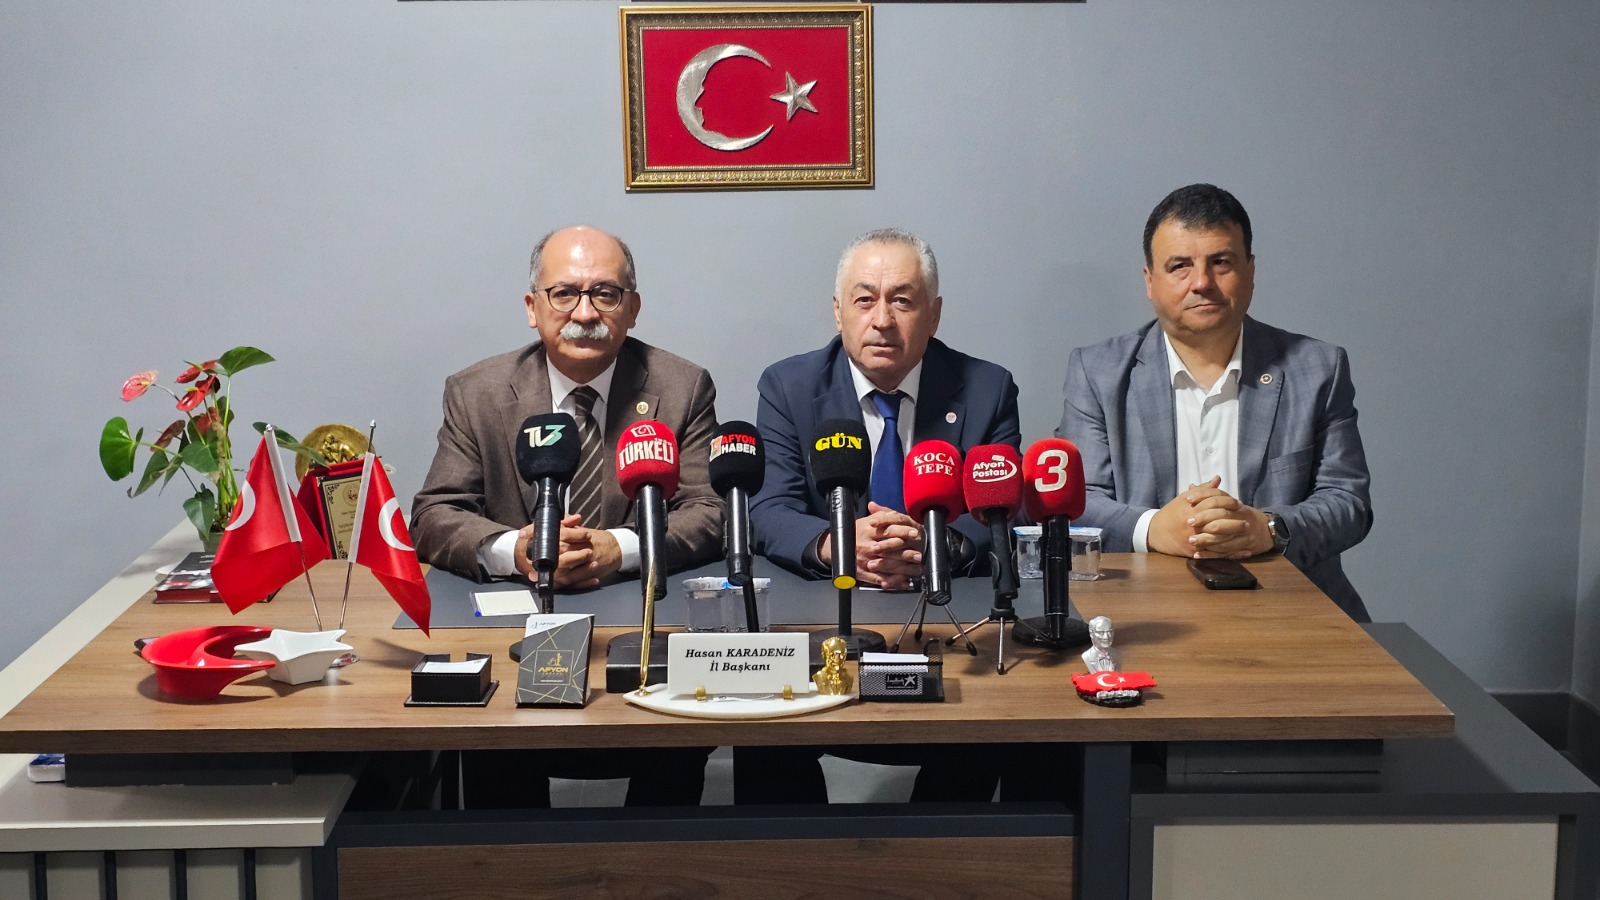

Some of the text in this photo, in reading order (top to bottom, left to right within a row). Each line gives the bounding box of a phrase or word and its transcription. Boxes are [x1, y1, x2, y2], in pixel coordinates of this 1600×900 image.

[523, 424, 567, 448] TV3
[722, 433, 757, 446] AFYON
[815, 432, 863, 451] GÜN
[721, 442, 757, 456] HABER
[913, 452, 955, 466] KOCA
[915, 463, 954, 476] TEPE
[973, 461, 1005, 471] Afyon
[1034, 449, 1069, 493] 3
[972, 469, 1008, 479] Postası
[685, 646, 795, 658] Hasan KARADENİZ
[709, 660, 771, 673] İl Başkanı
